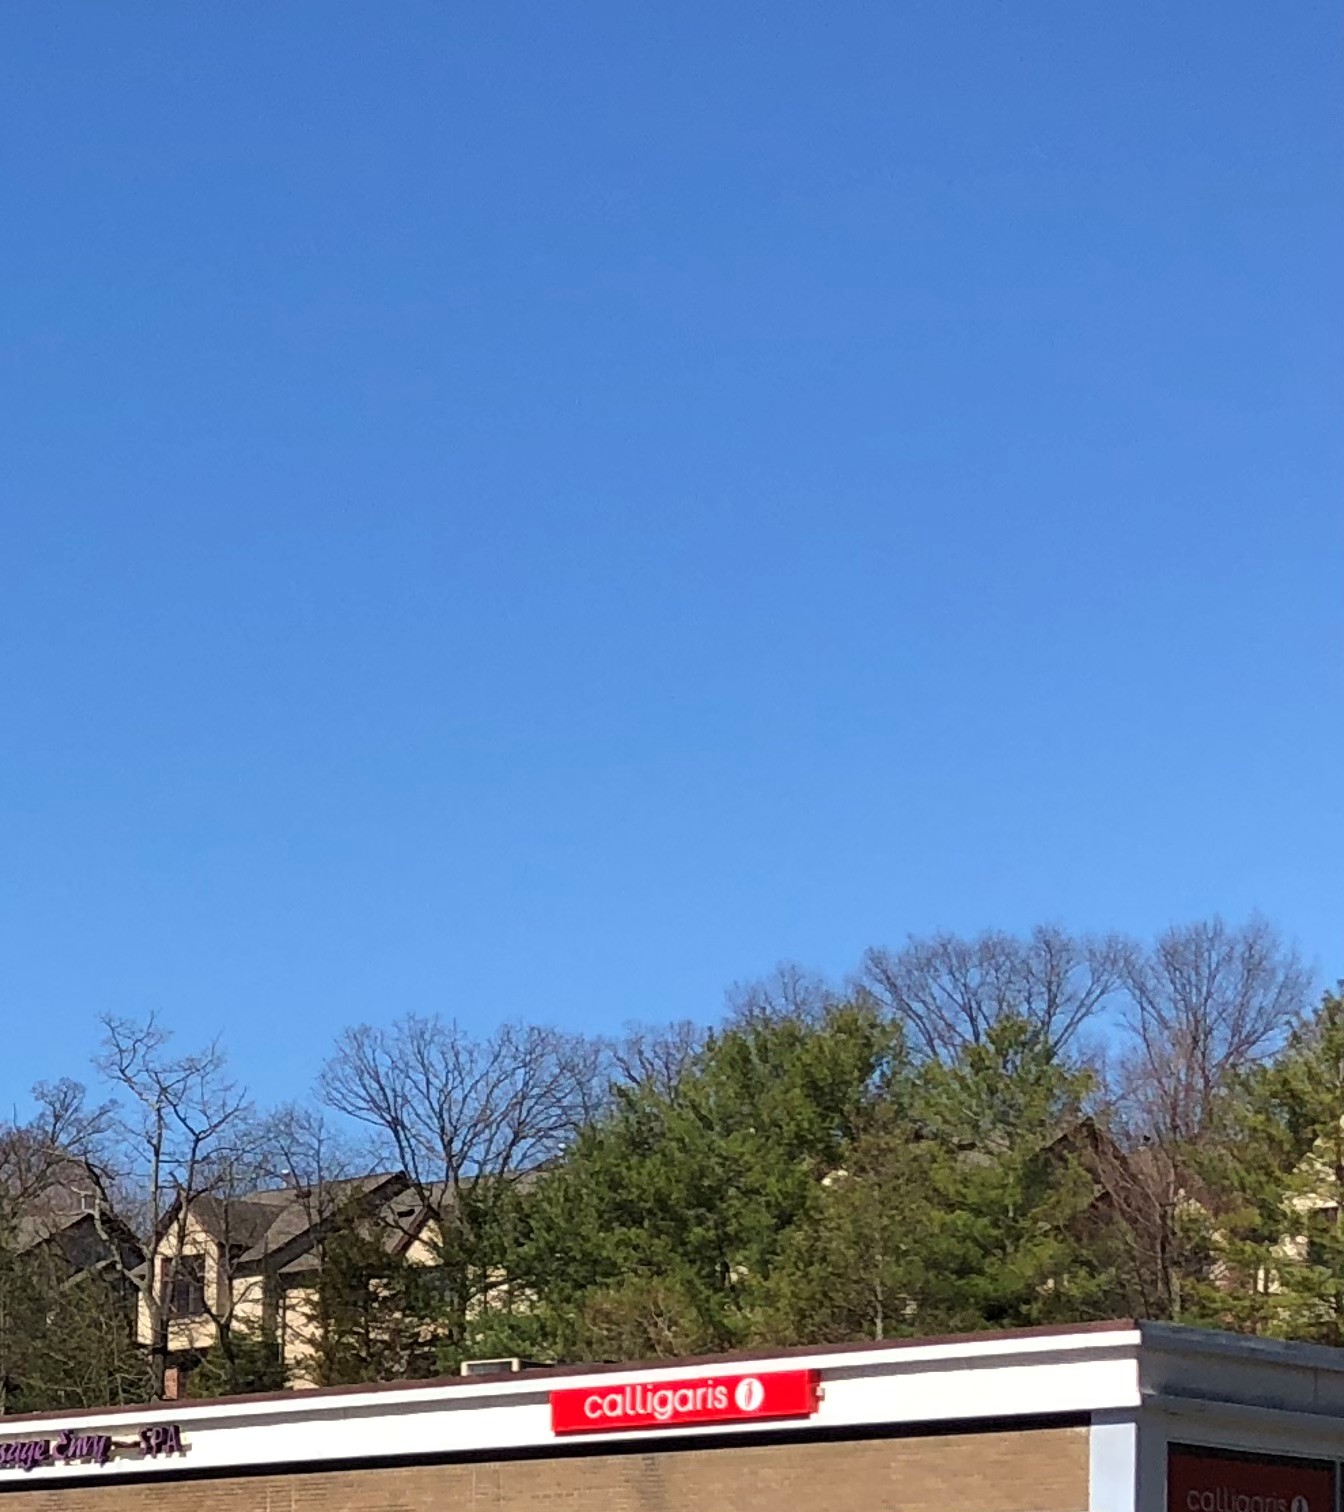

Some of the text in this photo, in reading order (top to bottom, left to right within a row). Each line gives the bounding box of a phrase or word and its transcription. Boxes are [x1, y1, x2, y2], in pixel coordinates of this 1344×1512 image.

[584, 1380, 728, 1420] calligaris
[52, 1430, 107, 1465] Envy
[139, 1425, 181, 1456] SPA
